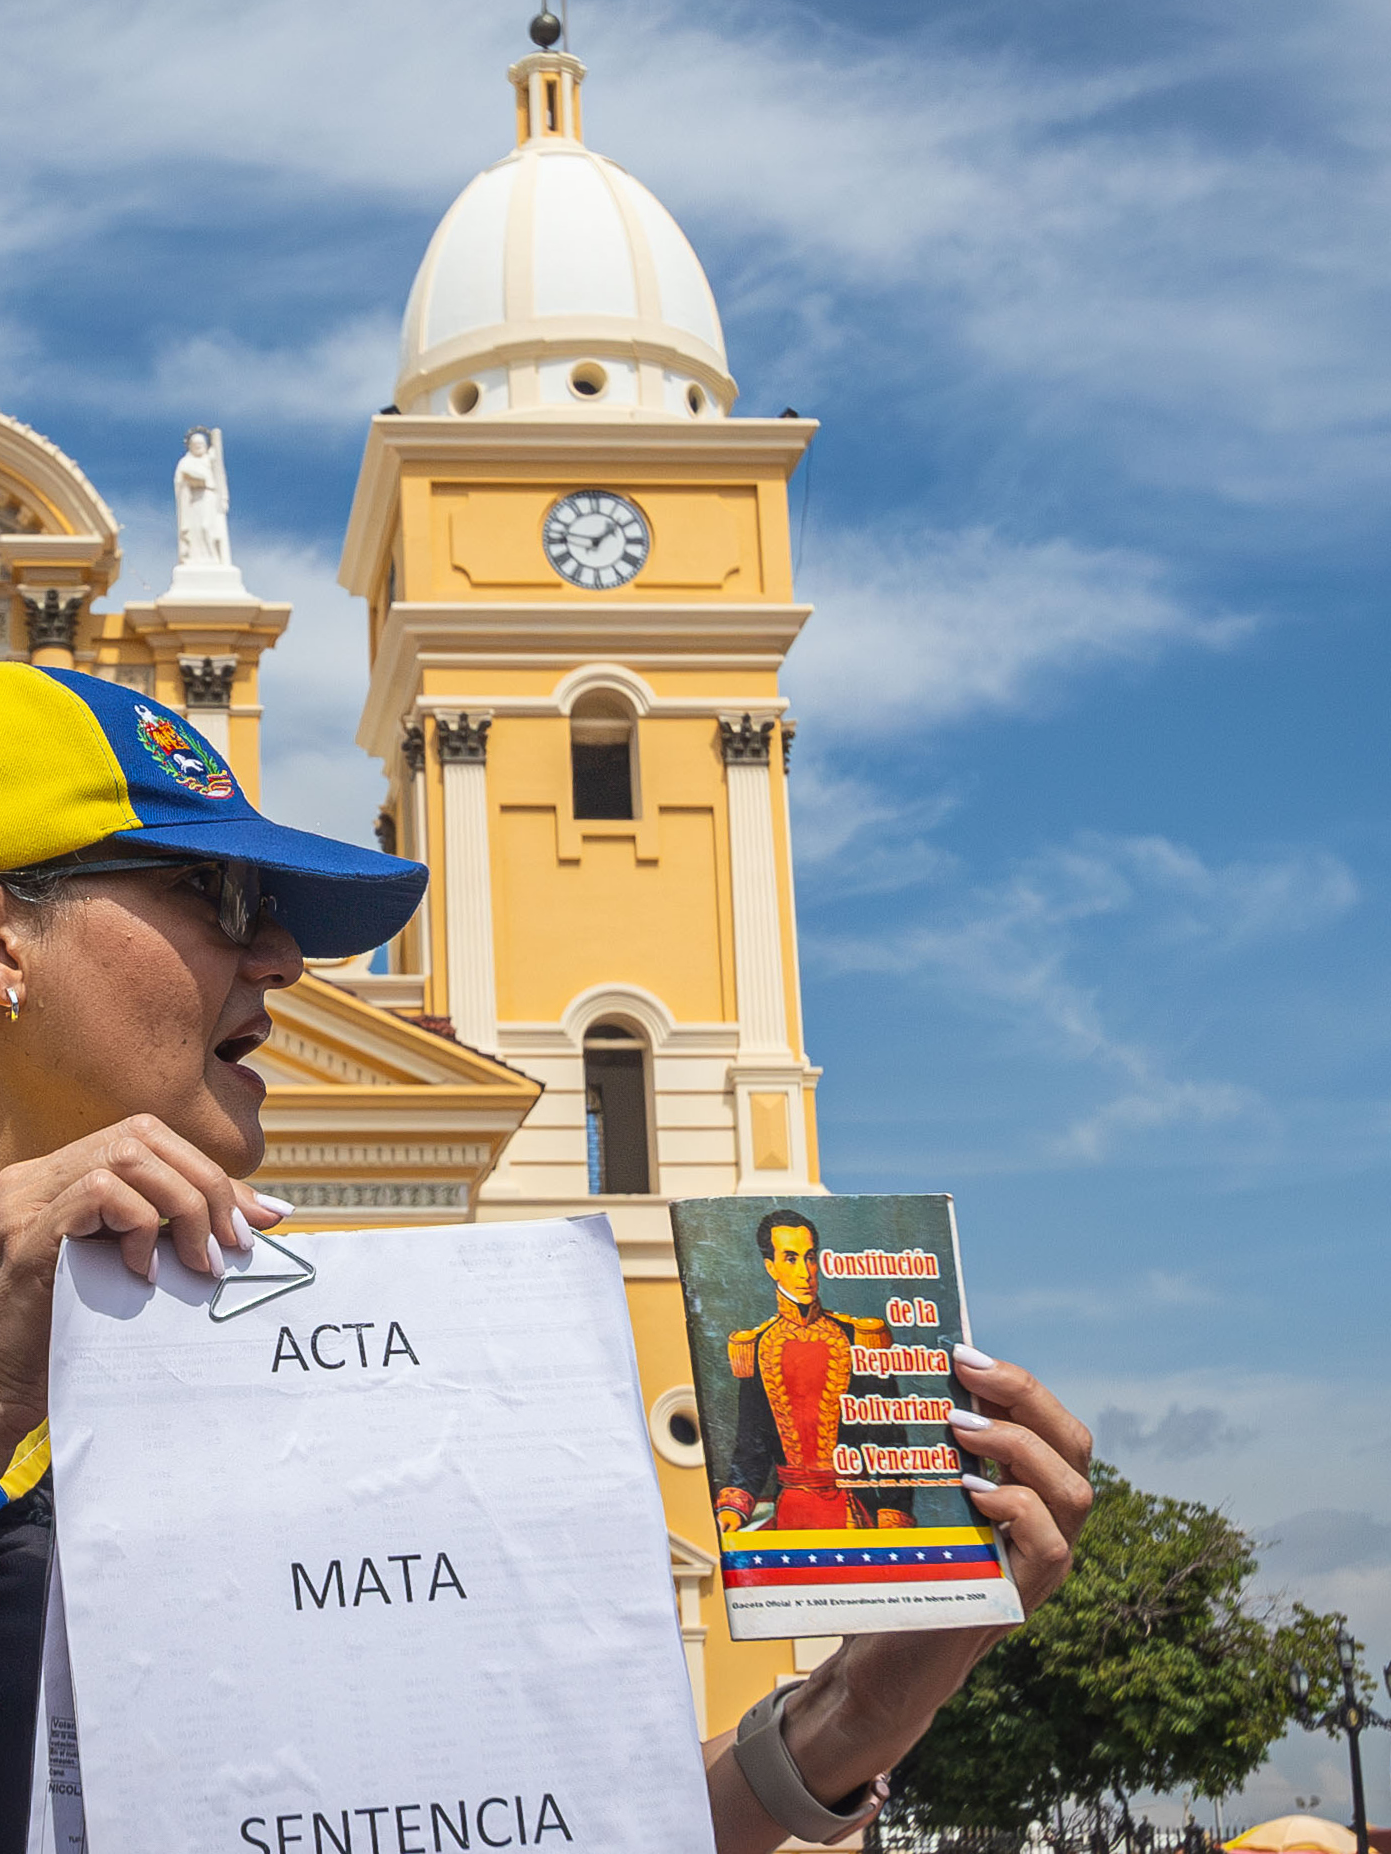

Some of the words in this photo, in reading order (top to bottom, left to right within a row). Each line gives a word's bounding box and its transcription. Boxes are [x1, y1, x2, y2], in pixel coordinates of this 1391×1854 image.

[821, 1249, 939, 1278] Constitución
[888, 1298, 914, 1325] de
[915, 1298, 938, 1325] la
[271, 1321, 421, 1373] ACTA
[852, 1345, 949, 1377] República
[841, 1395, 953, 1423] Bolivariana
[835, 1445, 861, 1473] de
[863, 1445, 960, 1472] Venezuela
[291, 1552, 467, 1611] MATA
[731, 1601, 764, 1610] Gaceta
[239, 1792, 573, 1854] SENTENCIA
